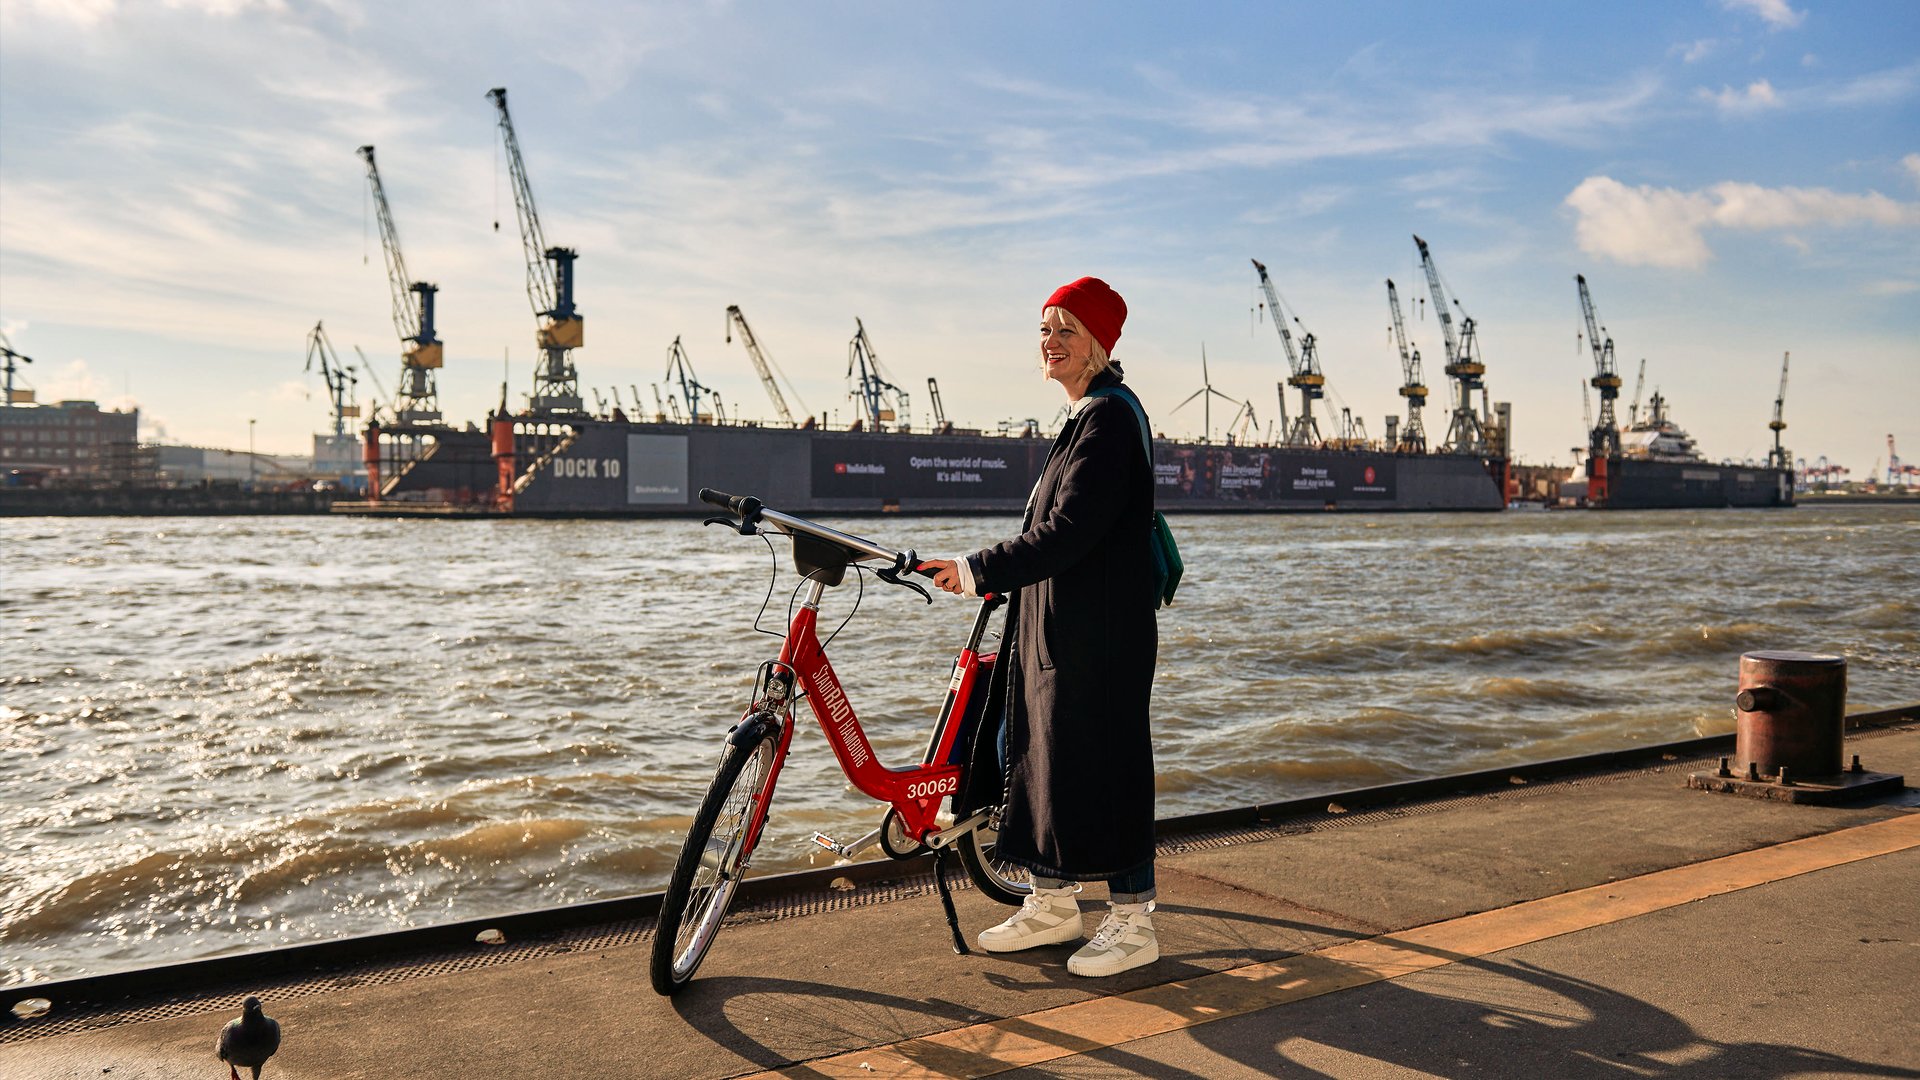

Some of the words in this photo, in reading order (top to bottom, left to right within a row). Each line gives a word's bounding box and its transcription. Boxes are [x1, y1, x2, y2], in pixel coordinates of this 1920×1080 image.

[554, 458, 597, 478] DOCK
[602, 459, 620, 478] 10
[867, 463, 886, 474] Music
[910, 456, 933, 469] Open
[934, 457, 948, 468] the
[949, 457, 972, 468] world
[972, 457, 982, 468] of
[982, 458, 1008, 469] music.
[937, 472, 950, 482] It's
[950, 471, 961, 482] all
[962, 471, 983, 482] here.
[907, 776, 957, 799] 30062
